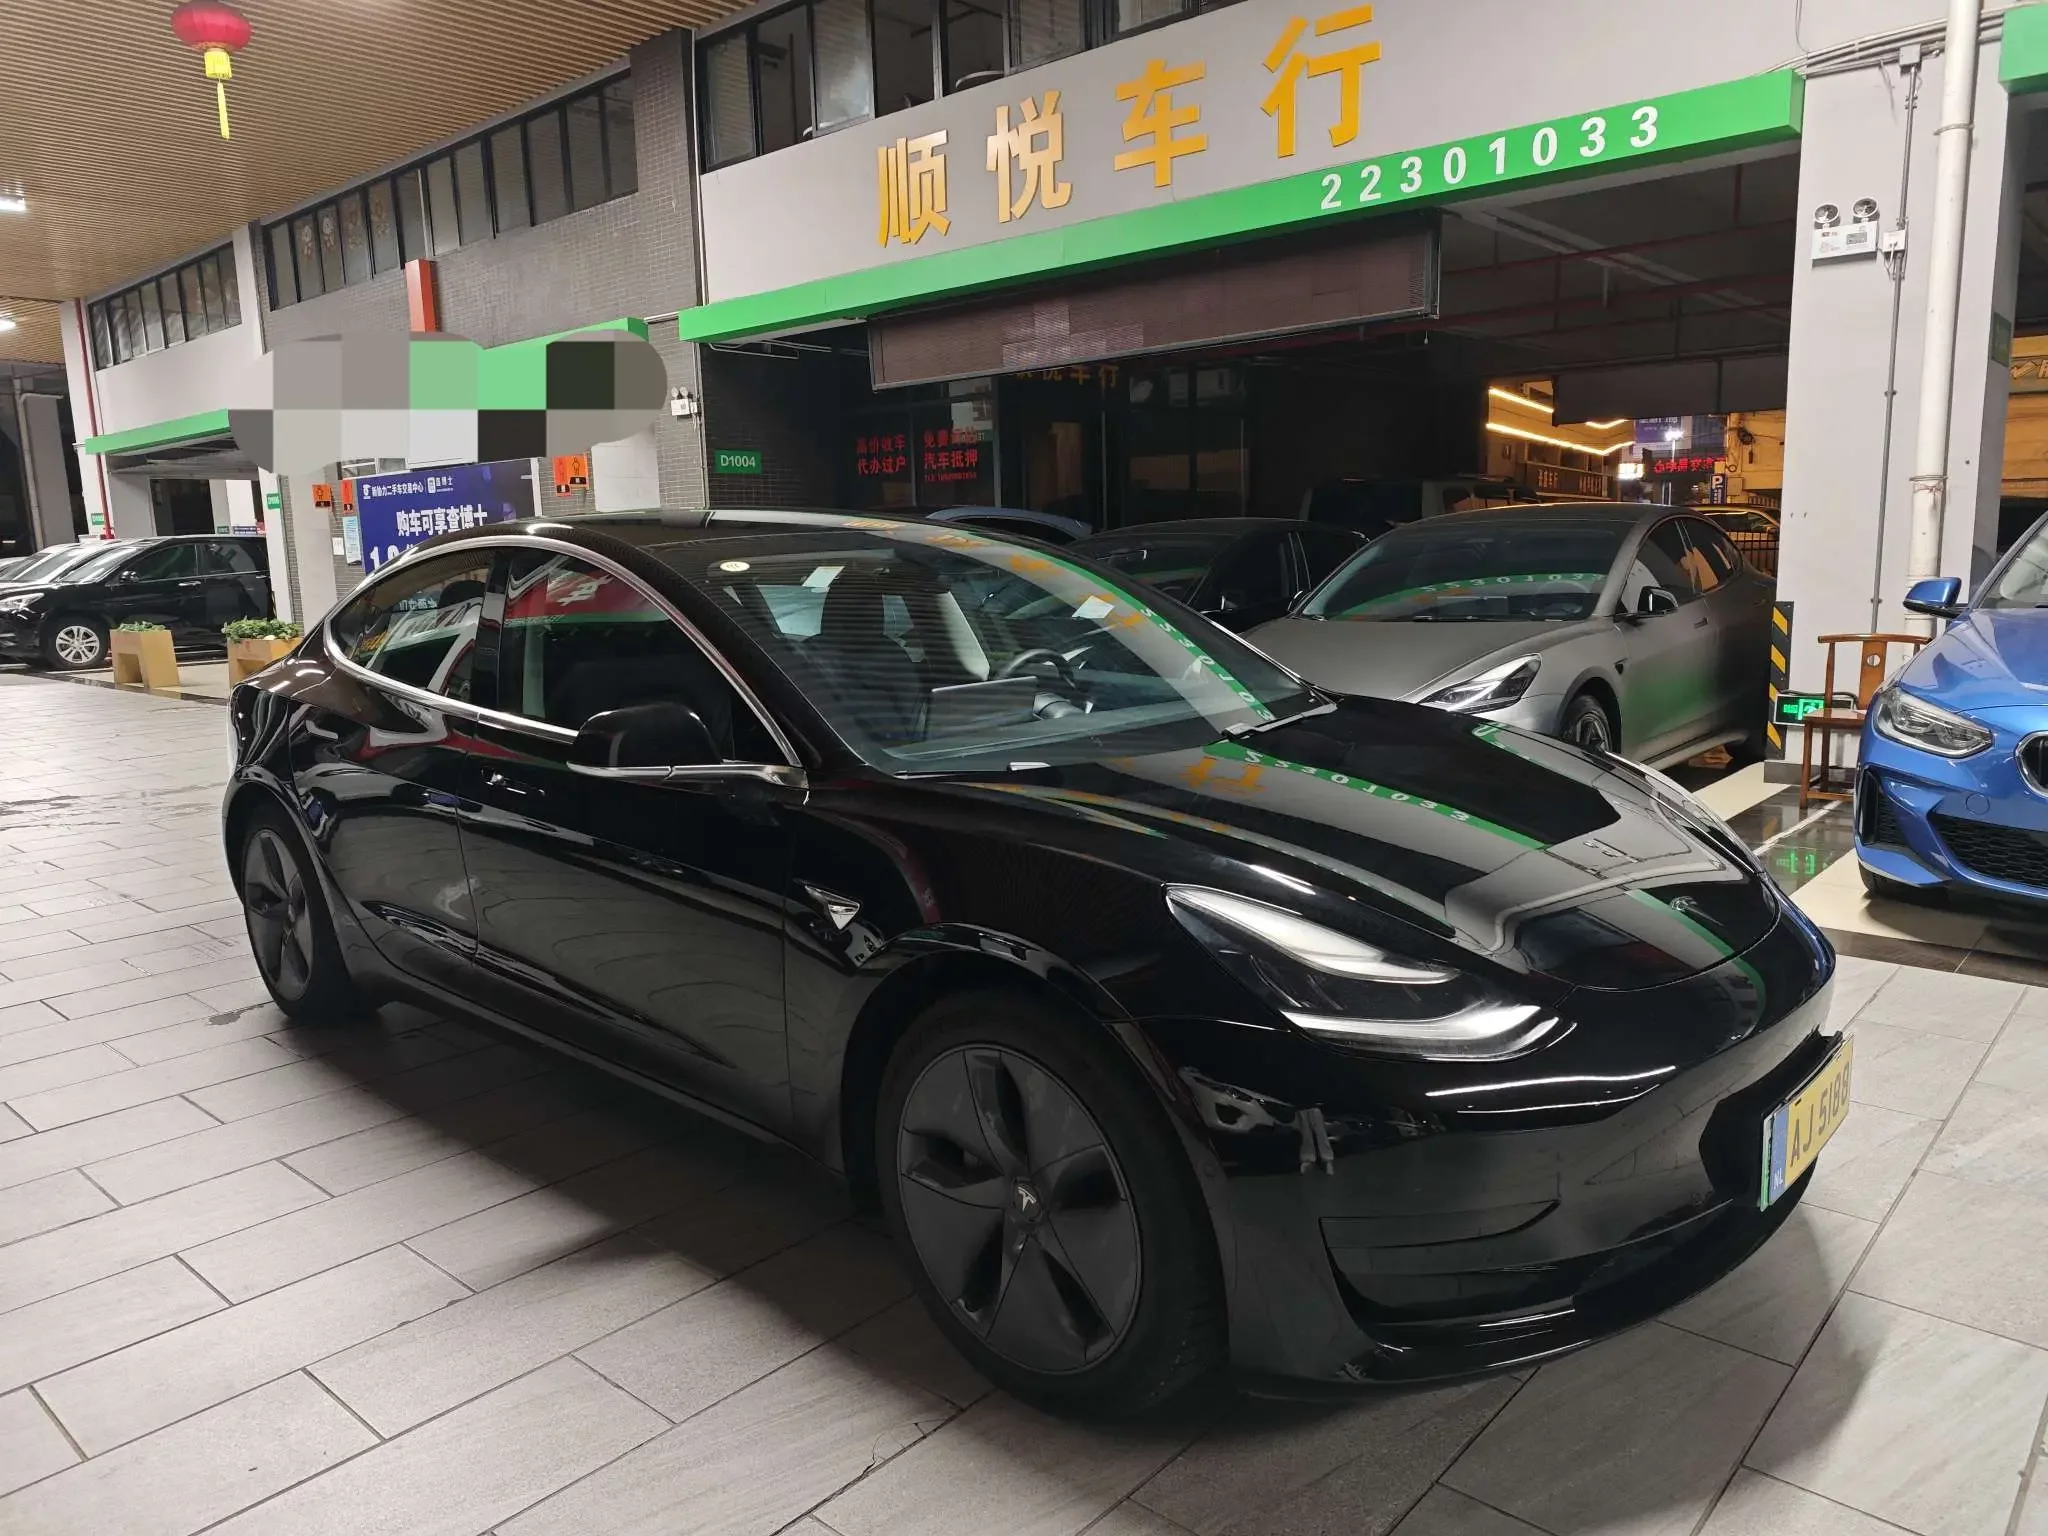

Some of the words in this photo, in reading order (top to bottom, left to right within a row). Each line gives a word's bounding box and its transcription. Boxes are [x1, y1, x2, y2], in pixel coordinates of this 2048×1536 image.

[877, 5, 1381, 248] 顺悦车行
[1320, 106, 1658, 212] 22301033
[719, 454, 757, 470] D1004
[923, 448, 978, 470] 汽车抵押
[1712, 475, 1724, 489] P
[1790, 1103, 1814, 1168] AJ
